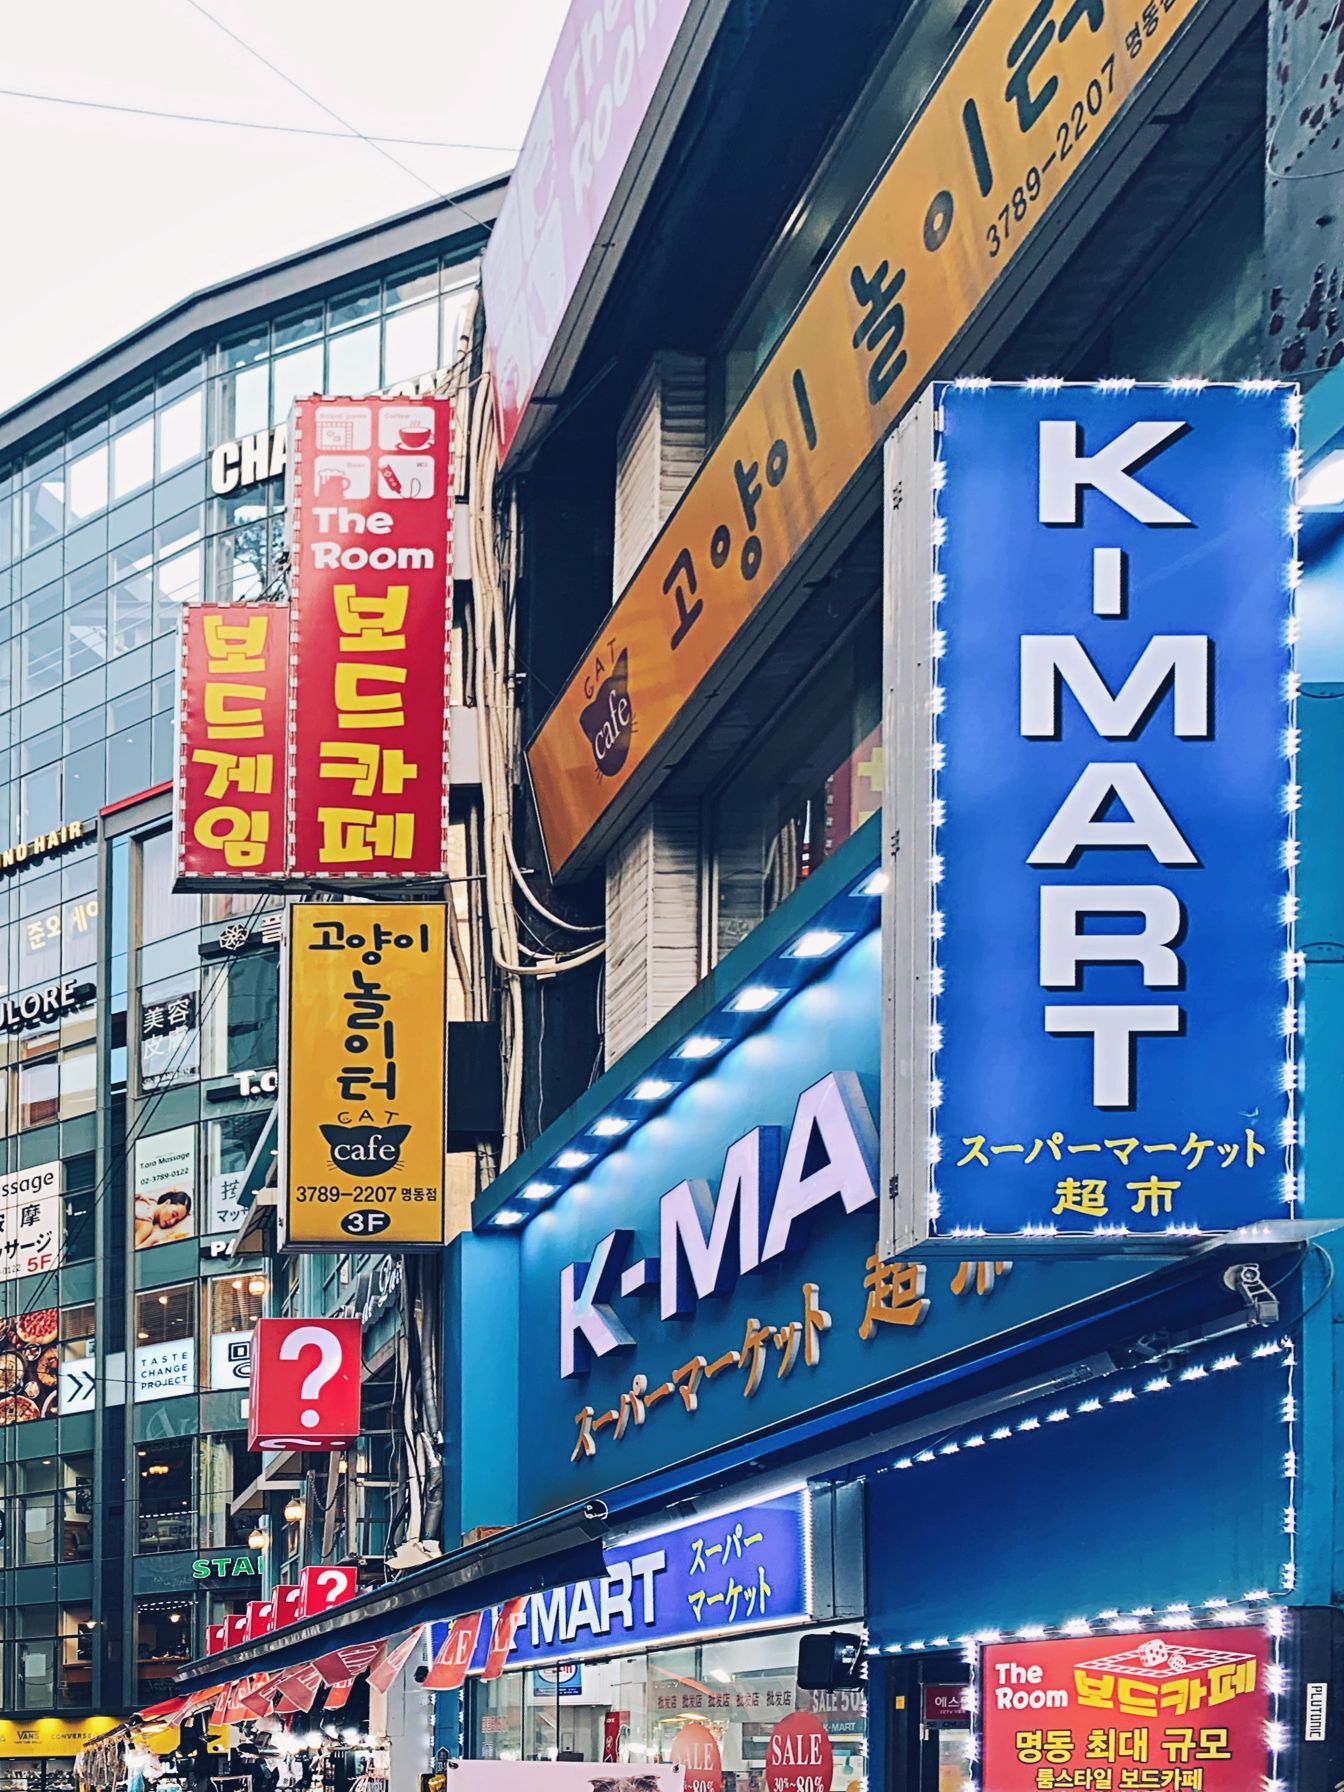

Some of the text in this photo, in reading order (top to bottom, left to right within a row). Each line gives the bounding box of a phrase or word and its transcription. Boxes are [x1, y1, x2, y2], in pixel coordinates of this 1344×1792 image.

[986, 53, 1115, 258] 3789-2207
[312, 506, 394, 536] The
[663, 368, 819, 651] 고양이
[312, 543, 435, 570] Room
[319, 584, 418, 864] 보드카페
[594, 689, 631, 761] cafe
[191, 614, 274, 868] 보드게임
[33, 820, 83, 854] HAIR
[308, 920, 429, 966] 고양이
[143, 998, 191, 1034] 美容
[336, 969, 397, 1101] 놀이터
[337, 1109, 400, 1124] CAT
[158, 1151, 190, 1165] Massage
[333, 1133, 397, 1162] cafe
[956, 1129, 1266, 1170] スーパーマーケット
[140, 1167, 189, 1185] 02-3789-0122
[295, 1184, 437, 1204] 3789-2207 명동점
[1051, 1175, 1182, 1217] 超市
[346, 1212, 386, 1234] 3F
[26, 1253, 53, 1273] 5F
[141, 1351, 188, 1367] TASTE
[141, 1363, 188, 1379] CHANGE
[570, 1281, 832, 1463] スーパーマーケット
[141, 1375, 188, 1391] PROJECT
[688, 1523, 763, 1576] スーパー
[687, 1566, 772, 1623] マーケット
[994, 1662, 1044, 1685] The
[1072, 1658, 1257, 1718] 보드카페
[766, 1690, 792, 1706] 批发店
[995, 1687, 1069, 1710] Room
[1308, 1685, 1323, 1739] PLUTONIC
[17, 1730, 40, 1741] VANS
[771, 1733, 823, 1766] SALE
[1015, 1726, 1232, 1764] 명동 최대 규모
[1035, 1767, 1204, 1791] 룸스타일 보드카페
